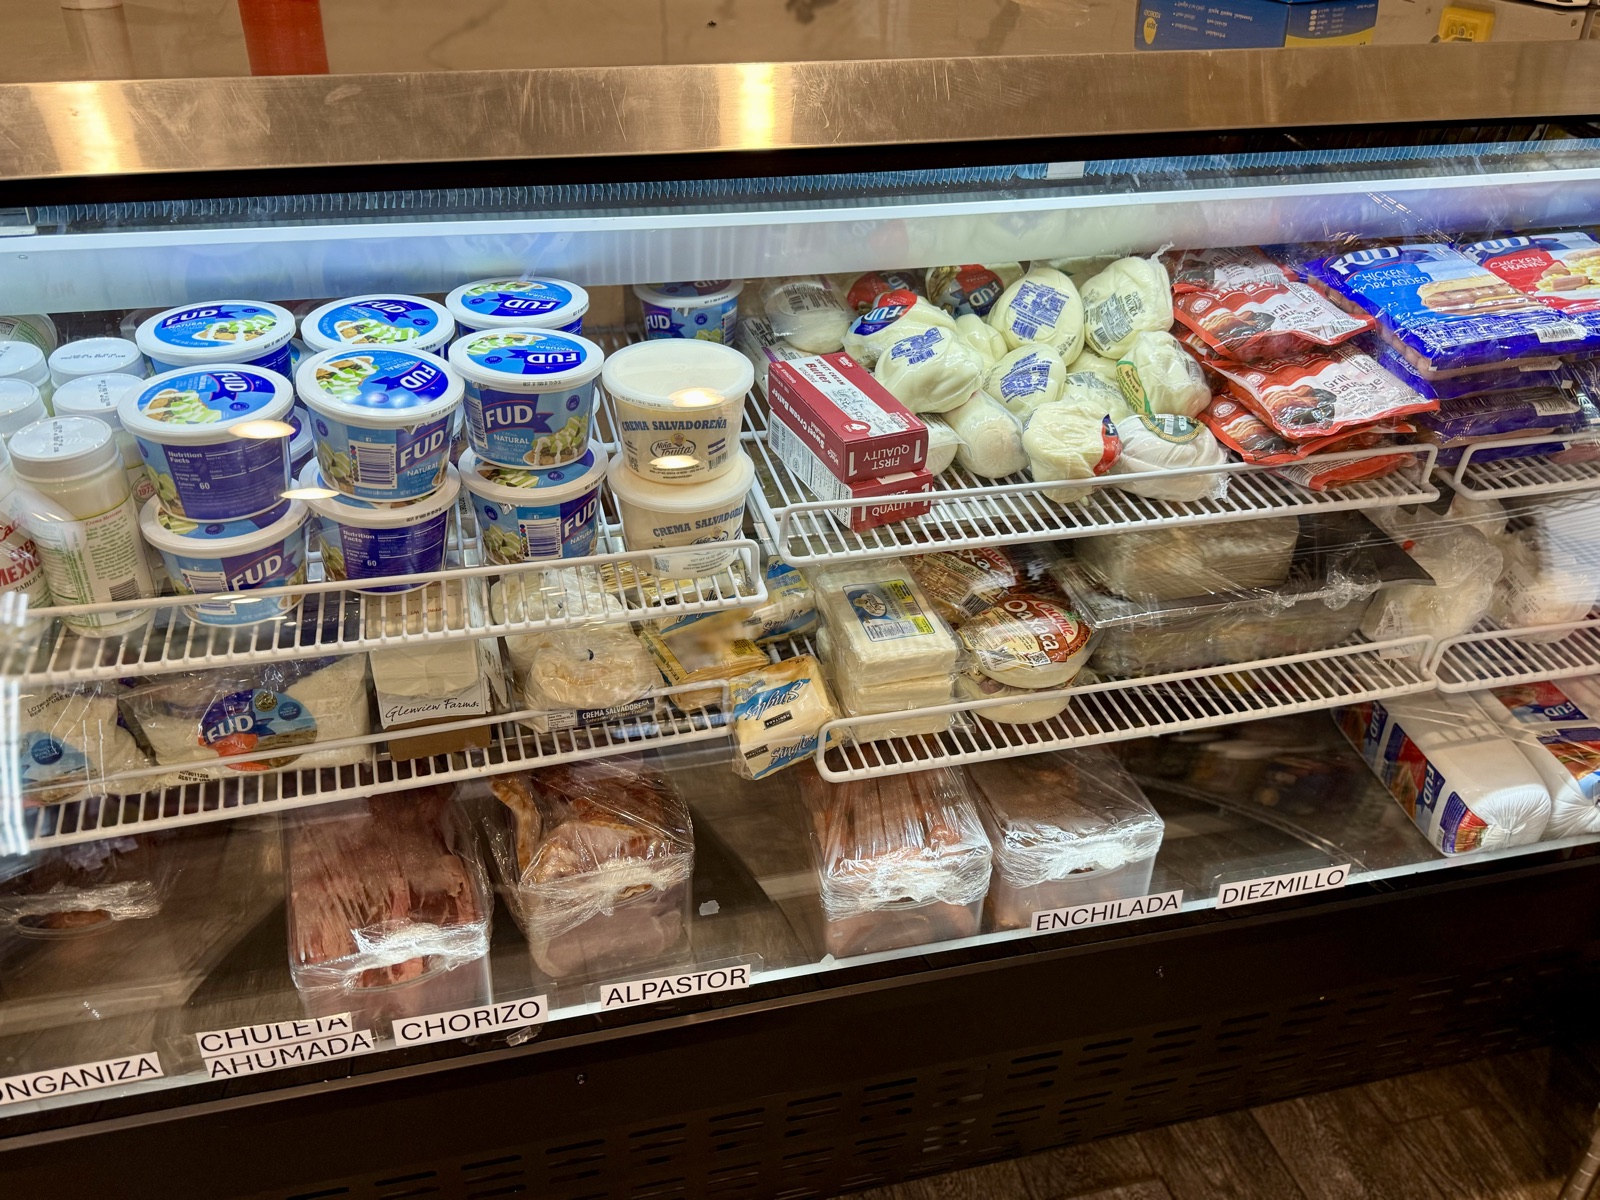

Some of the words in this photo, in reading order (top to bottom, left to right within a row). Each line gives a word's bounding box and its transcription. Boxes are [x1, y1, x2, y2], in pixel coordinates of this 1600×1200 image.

[1462, 236, 1530, 264] FUD
[1331, 246, 1400, 275] FUD
[1489, 256, 1542, 269] CHICKEN
[1353, 268, 1411, 282] CHICKEN
[1391, 276, 1430, 288] ADDED
[525, 292, 558, 301] NATURAL
[969, 281, 1000, 307] FUD
[358, 301, 406, 313] FUD
[504, 299, 557, 310] FUD
[864, 305, 903, 321] FUD
[166, 309, 219, 327] FUD
[168, 320, 207, 330] NATURAL
[646, 314, 671, 330] FUD
[526, 353, 577, 364] FUD
[213, 372, 248, 392] FUD
[400, 364, 437, 389] FUD
[1322, 373, 1352, 389] Grill
[771, 388, 790, 411] Butter
[485, 405, 533, 429] FUD
[621, 420, 650, 432] CREMA
[653, 416, 727, 431] SALVADOREÑA
[789, 406, 808, 432] Cream
[493, 433, 530, 445] NATURAL
[807, 426, 826, 450] Sweet
[167, 450, 203, 459] Nutrition
[400, 430, 444, 469] FUD
[863, 444, 910, 462] QUALITY
[406, 462, 440, 477] NATURAL
[871, 456, 901, 471] FIRST
[199, 481, 211, 490] 60
[564, 497, 598, 538] FUD
[343, 529, 375, 540] Nutrition
[652, 522, 692, 538] CREMA
[344, 535, 363, 544] Facts
[366, 559, 377, 567] 60
[230, 554, 283, 592] FUD
[13, 575, 40, 593] TABLE
[1003, 599, 1060, 651] Oaxaca
[1035, 602, 1075, 638] Cacique
[744, 680, 804, 722] Singles
[1544, 701, 1576, 717] FUD
[385, 703, 441, 722] Glenview
[582, 709, 605, 720] CREMA
[1369, 700, 1385, 739] FUD
[206, 714, 254, 743] FUD
[769, 734, 816, 766] Singles
[1424, 764, 1436, 806] FUD
[1222, 869, 1345, 904] DIEZMILLO
[1036, 894, 1179, 932] ENCHILADA
[606, 967, 747, 1006] ALPASTOR
[401, 1000, 541, 1042] CHORIZO
[200, 1017, 348, 1053] CHULETA
[211, 1032, 372, 1078] AHUMADA
